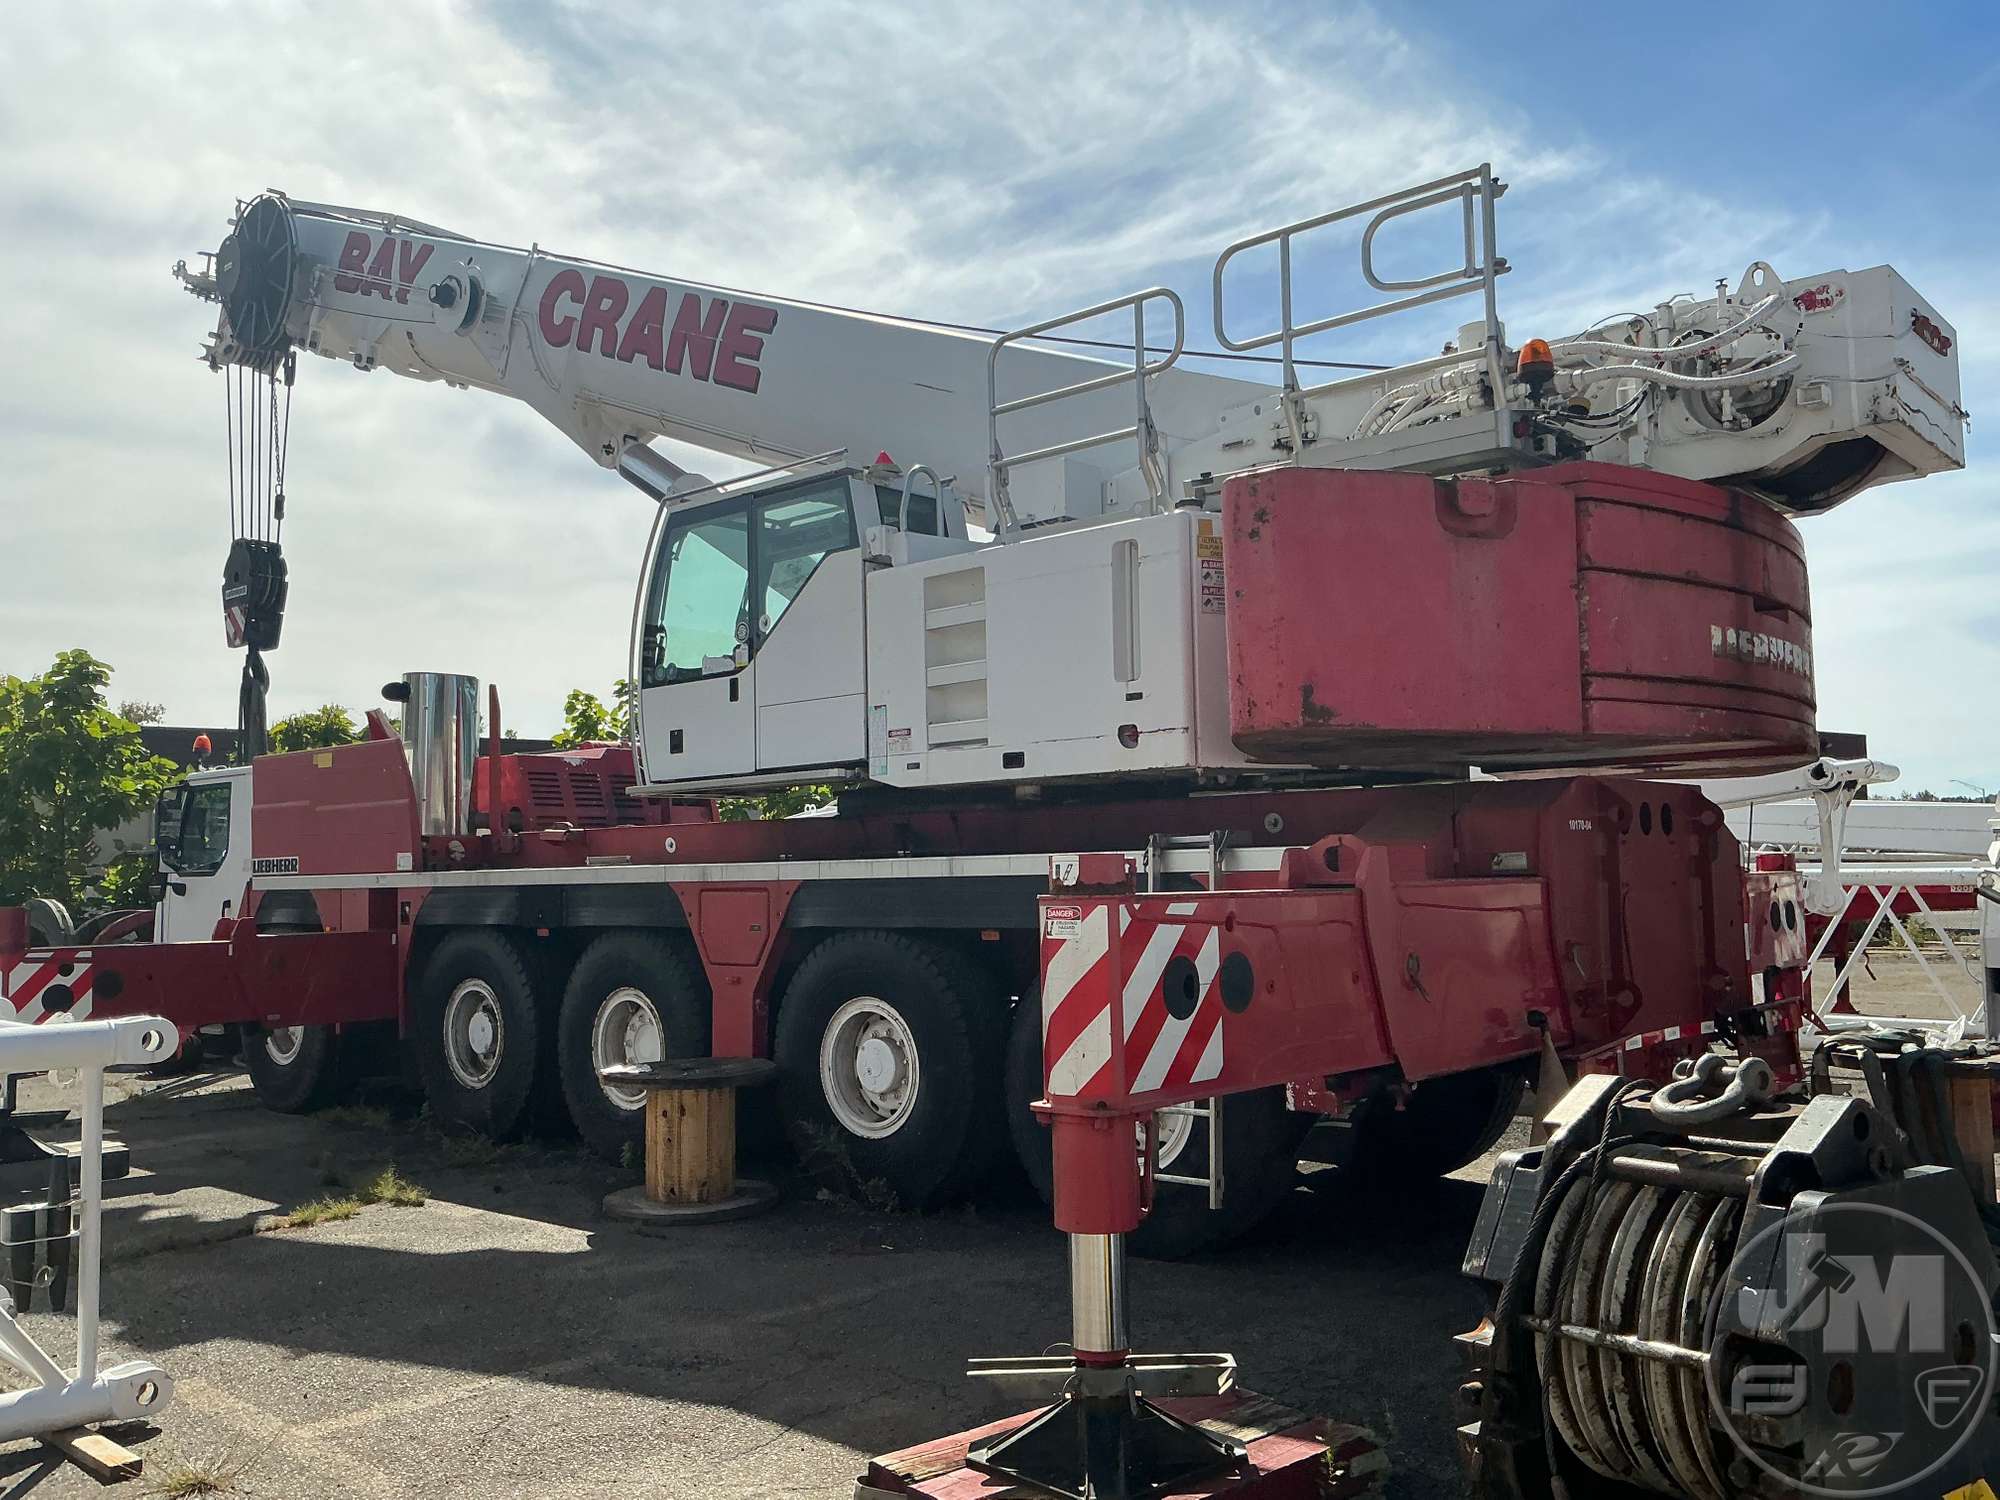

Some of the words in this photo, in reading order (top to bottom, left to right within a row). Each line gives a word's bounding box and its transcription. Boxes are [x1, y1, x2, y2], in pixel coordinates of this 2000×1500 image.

[335, 231, 435, 304] BAY
[538, 269, 779, 394] CRANE
[252, 859, 298, 873] LIEBHERR
